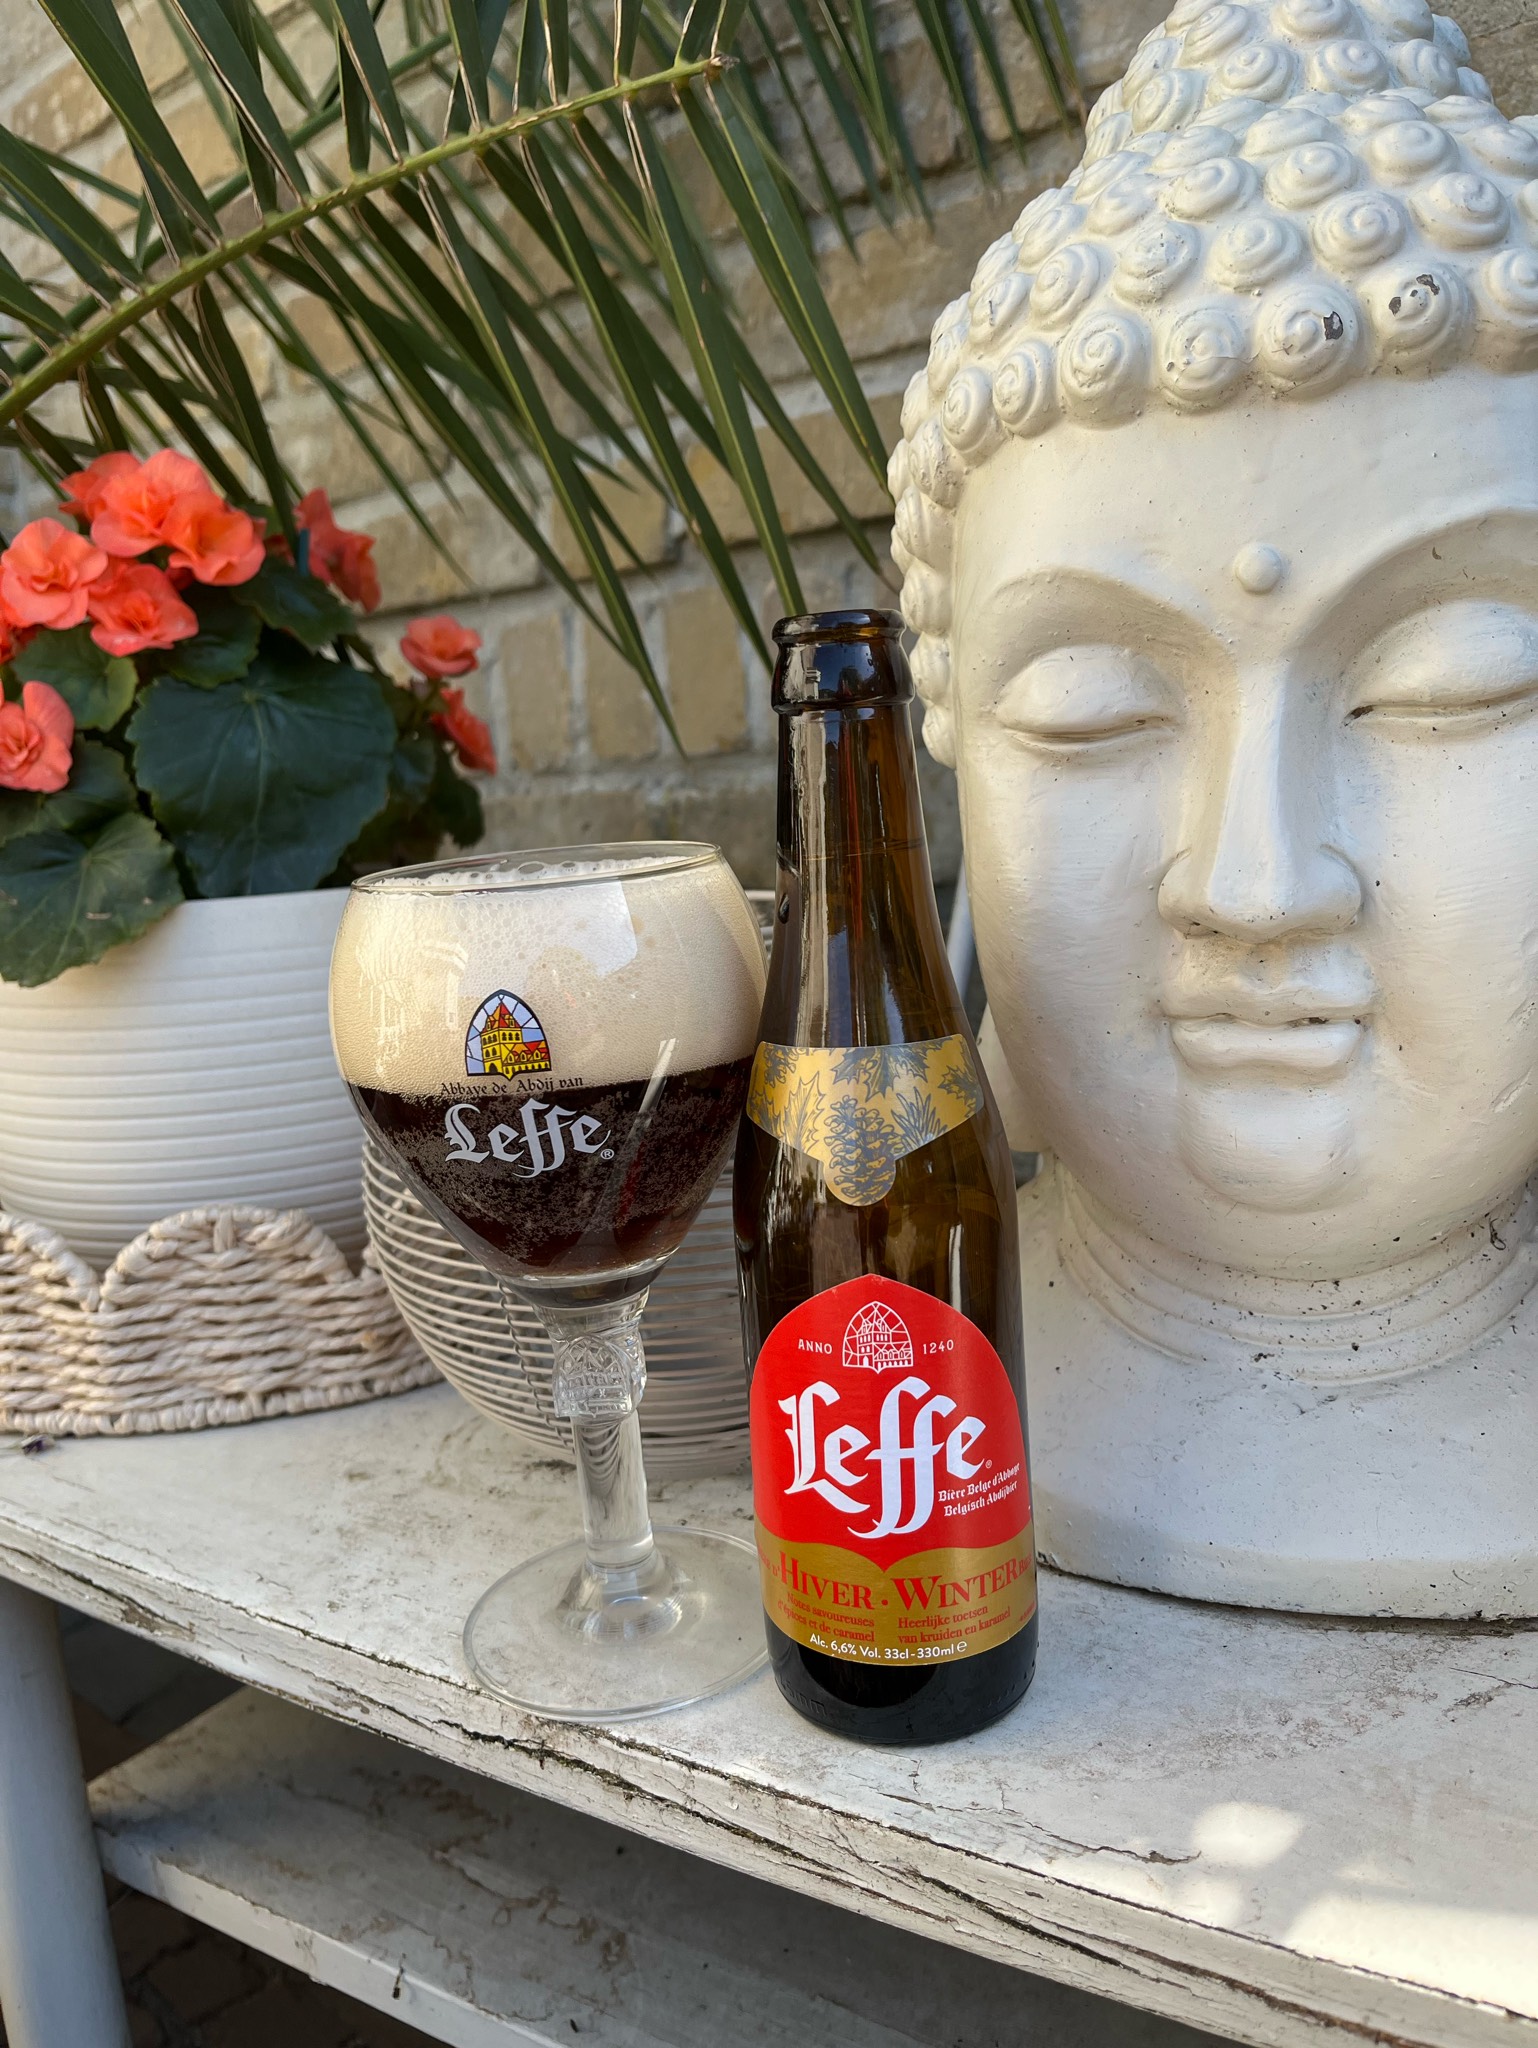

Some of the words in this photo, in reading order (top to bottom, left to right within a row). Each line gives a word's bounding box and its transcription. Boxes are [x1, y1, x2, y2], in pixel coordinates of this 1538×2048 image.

[440, 1082, 488, 1096] Abbaye
[492, 1082, 507, 1094] de
[516, 1078, 554, 1094] Abdij
[559, 1077, 583, 1089] van
[444, 1097, 611, 1179] Leffe
[797, 1338, 833, 1355] ANNO
[921, 1339, 954, 1355] 1240
[778, 1376, 987, 1539] Leffe
[938, 1489, 965, 1501] Bière
[967, 1480, 991, 1495] Belge
[944, 1496, 986, 1516] Belgisch
[986, 1480, 1017, 1505] Abdijbier
[787, 1592, 811, 1612] Notes
[812, 1606, 875, 1627] savoureuses
[898, 1615, 950, 1630] Heerlijke
[953, 1606, 988, 1623] toetsen
[808, 1620, 817, 1630] et
[819, 1621, 831, 1634] de
[833, 1628, 875, 1642] caramel
[898, 1633, 917, 1644] van
[920, 1628, 963, 1642] kruiden
[965, 1624, 977, 1635] en
[978, 1606, 1011, 1631] karamel
[809, 1633, 828, 1648] Alc.
[830, 1639, 857, 1655] 6,6%
[859, 1645, 881, 1659] Vol.
